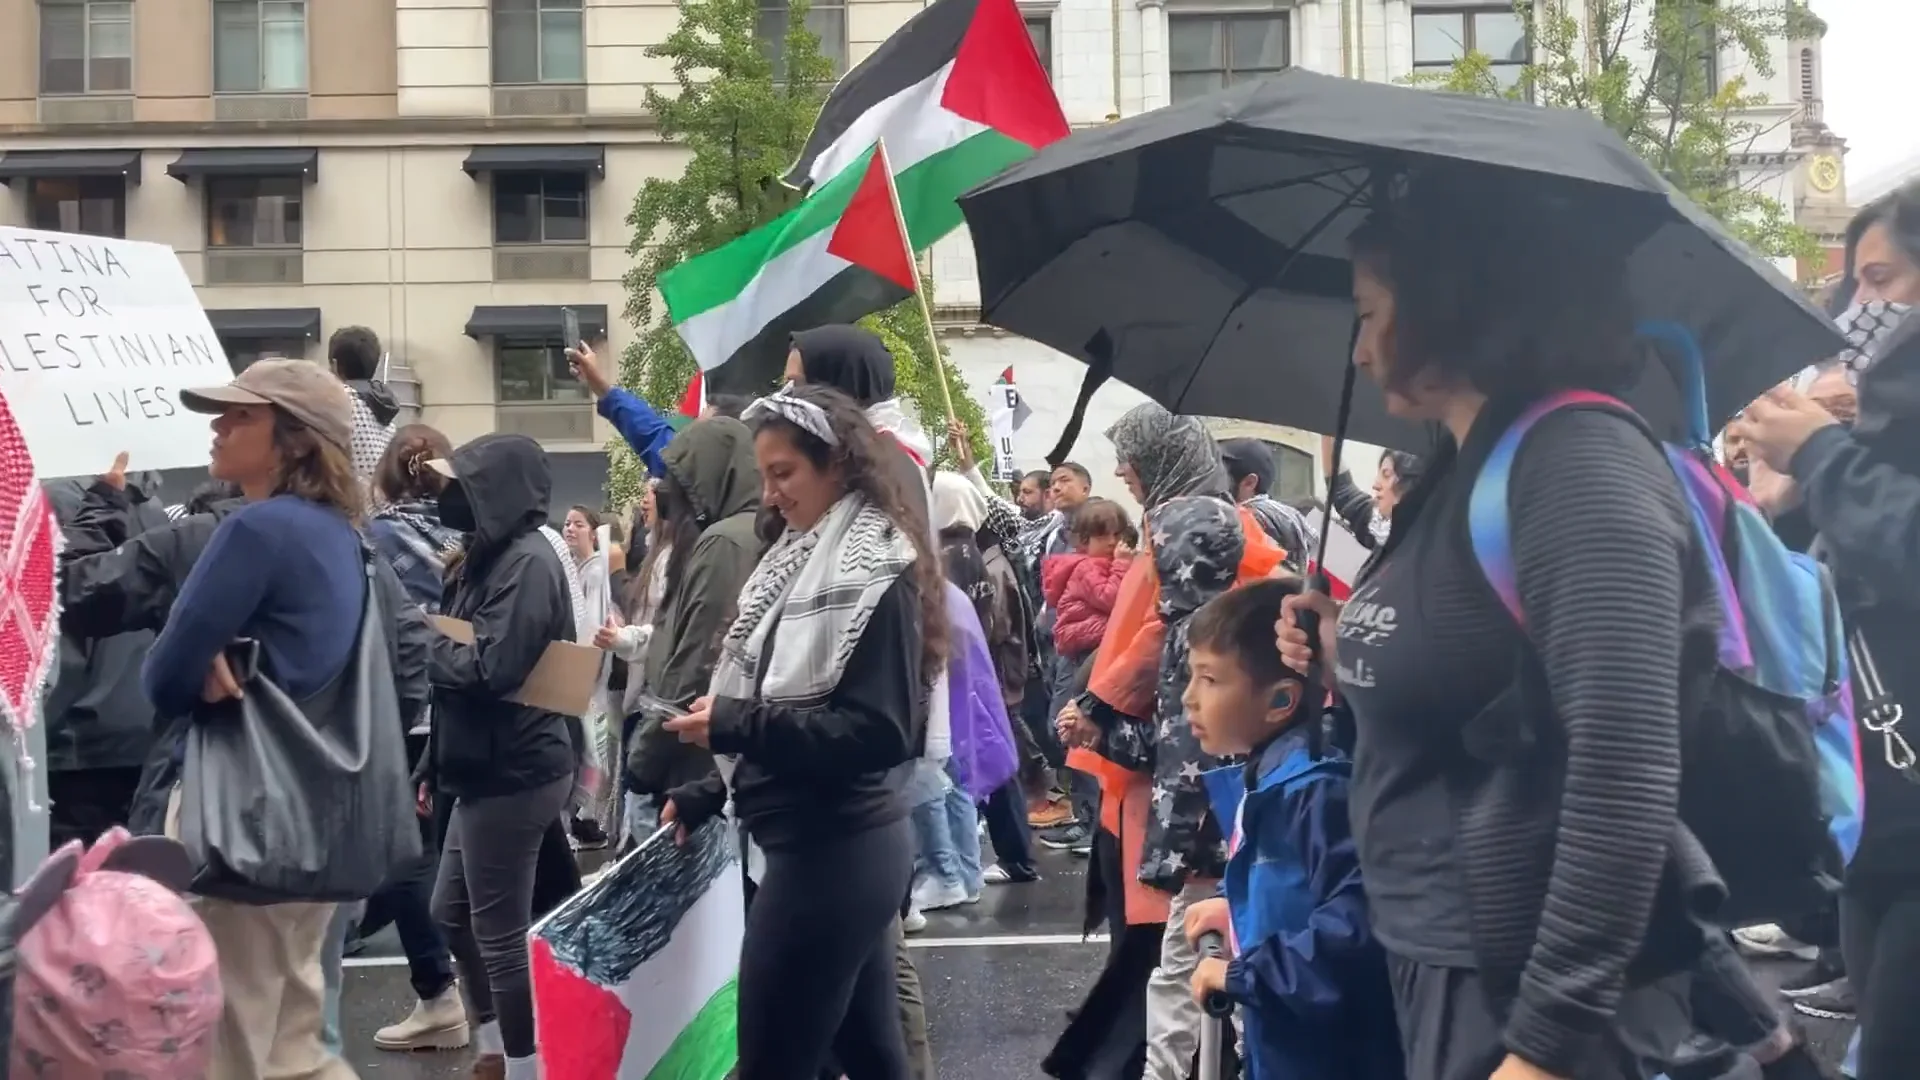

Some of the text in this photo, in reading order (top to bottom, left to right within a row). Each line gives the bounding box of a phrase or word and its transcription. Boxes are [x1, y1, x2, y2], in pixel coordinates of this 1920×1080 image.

[27, 285, 112, 317] FOR
[0, 333, 214, 371] LESTINIAN
[64, 386, 175, 426] LIVES
